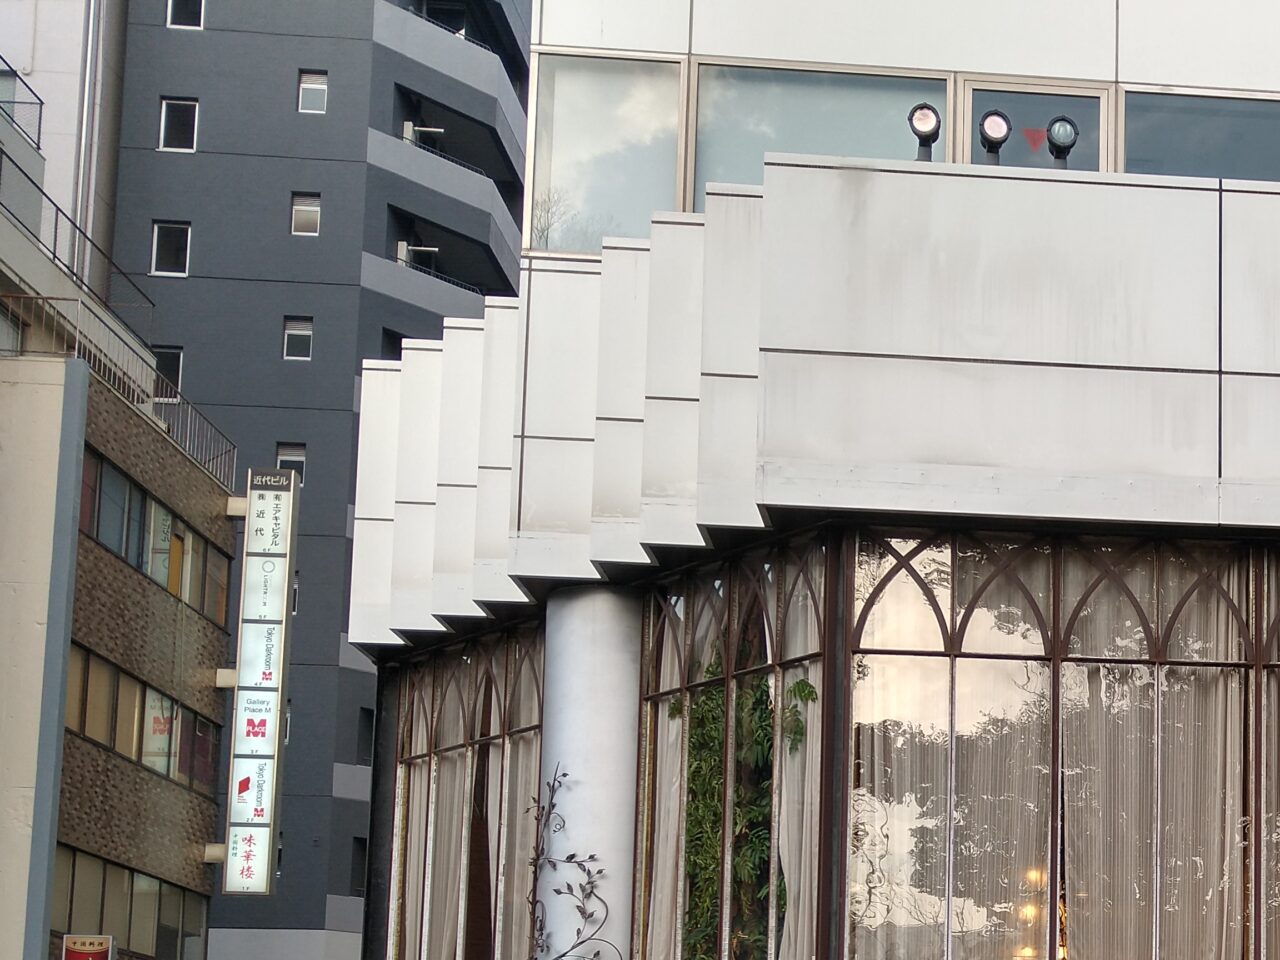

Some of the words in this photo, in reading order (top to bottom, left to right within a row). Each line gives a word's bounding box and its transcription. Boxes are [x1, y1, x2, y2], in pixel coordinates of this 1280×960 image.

[253, 475, 289, 486] 近代ビル
[264, 626, 275, 643] Tokyo
[263, 643, 274, 671] Darkroom
[244, 706, 263, 714] Place
[246, 698, 270, 706] Gallery
[256, 762, 267, 779] Tokyo
[255, 779, 266, 807] Darkroom
[240, 833, 257, 880] 味華楼
